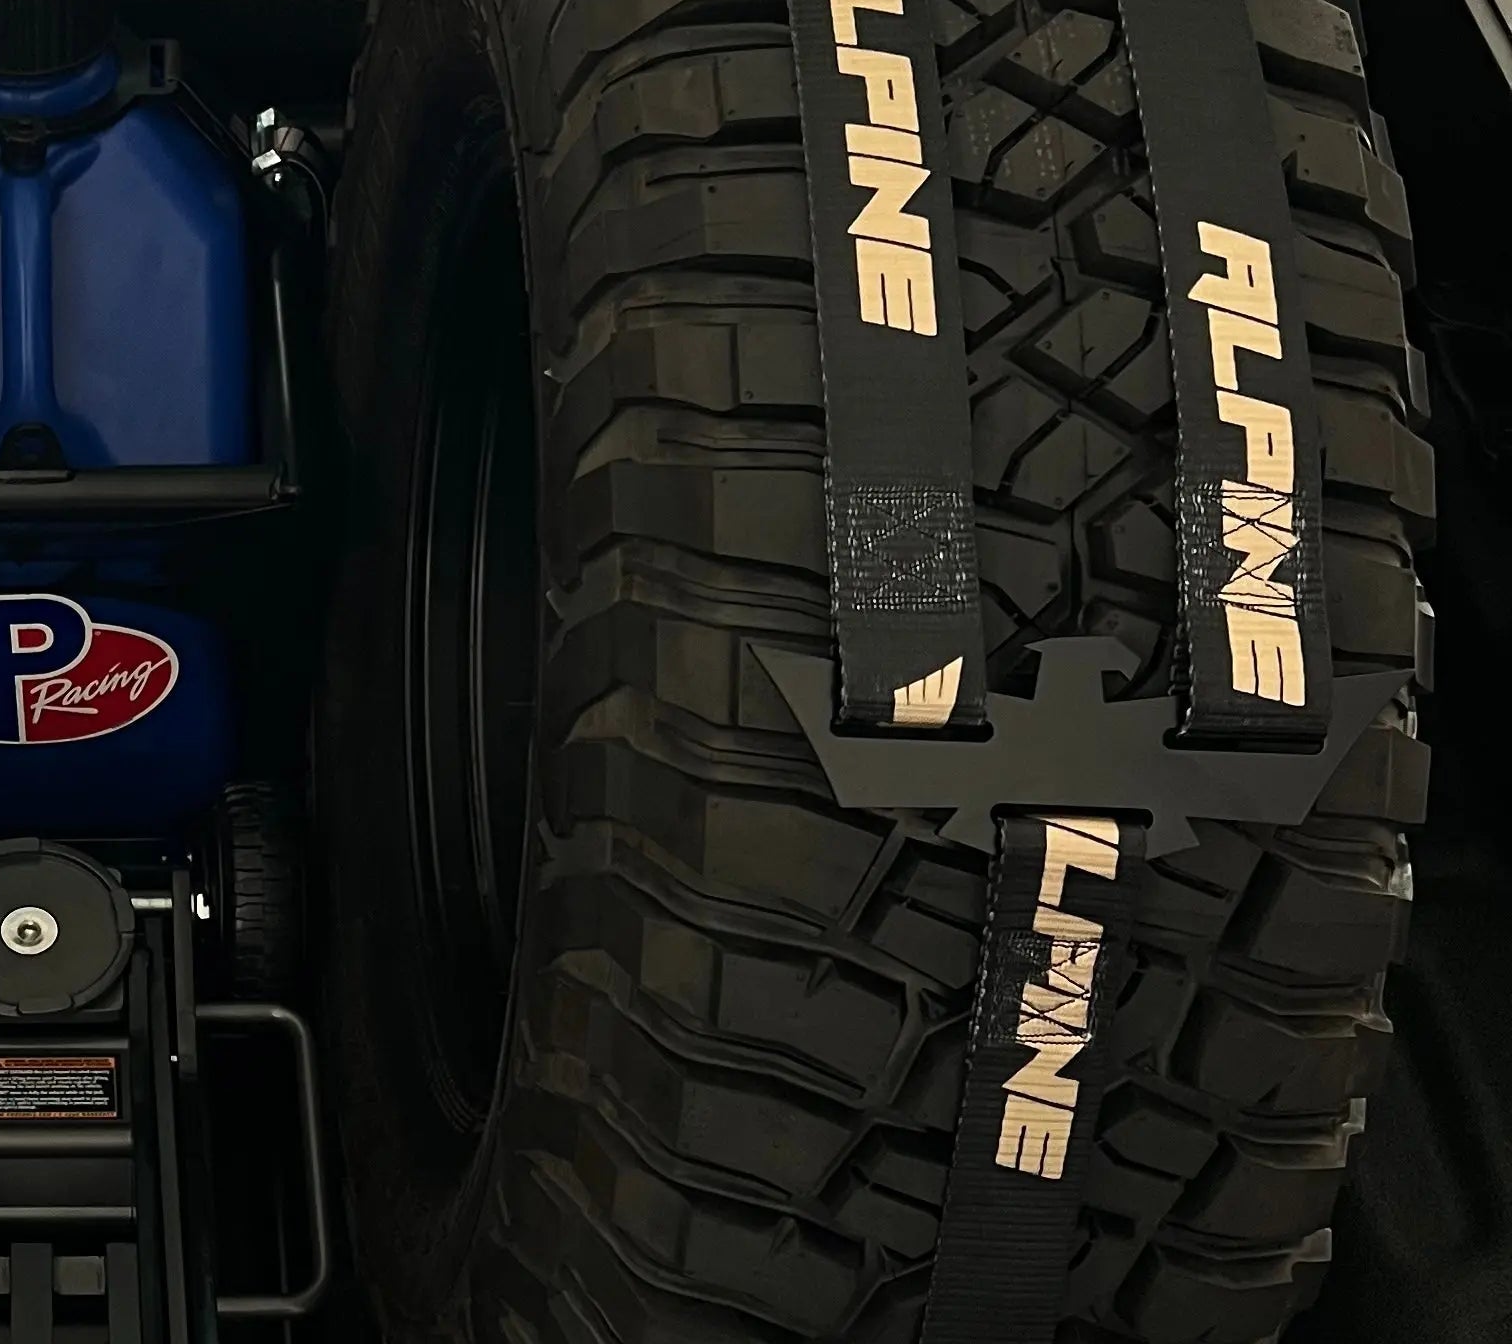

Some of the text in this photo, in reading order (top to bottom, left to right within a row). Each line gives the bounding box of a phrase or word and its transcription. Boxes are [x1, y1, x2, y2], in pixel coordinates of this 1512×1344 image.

[1187, 221, 1307, 708] ALPINE
[30, 651, 170, 724] Racing
[995, 816, 1119, 1180] LPINE
